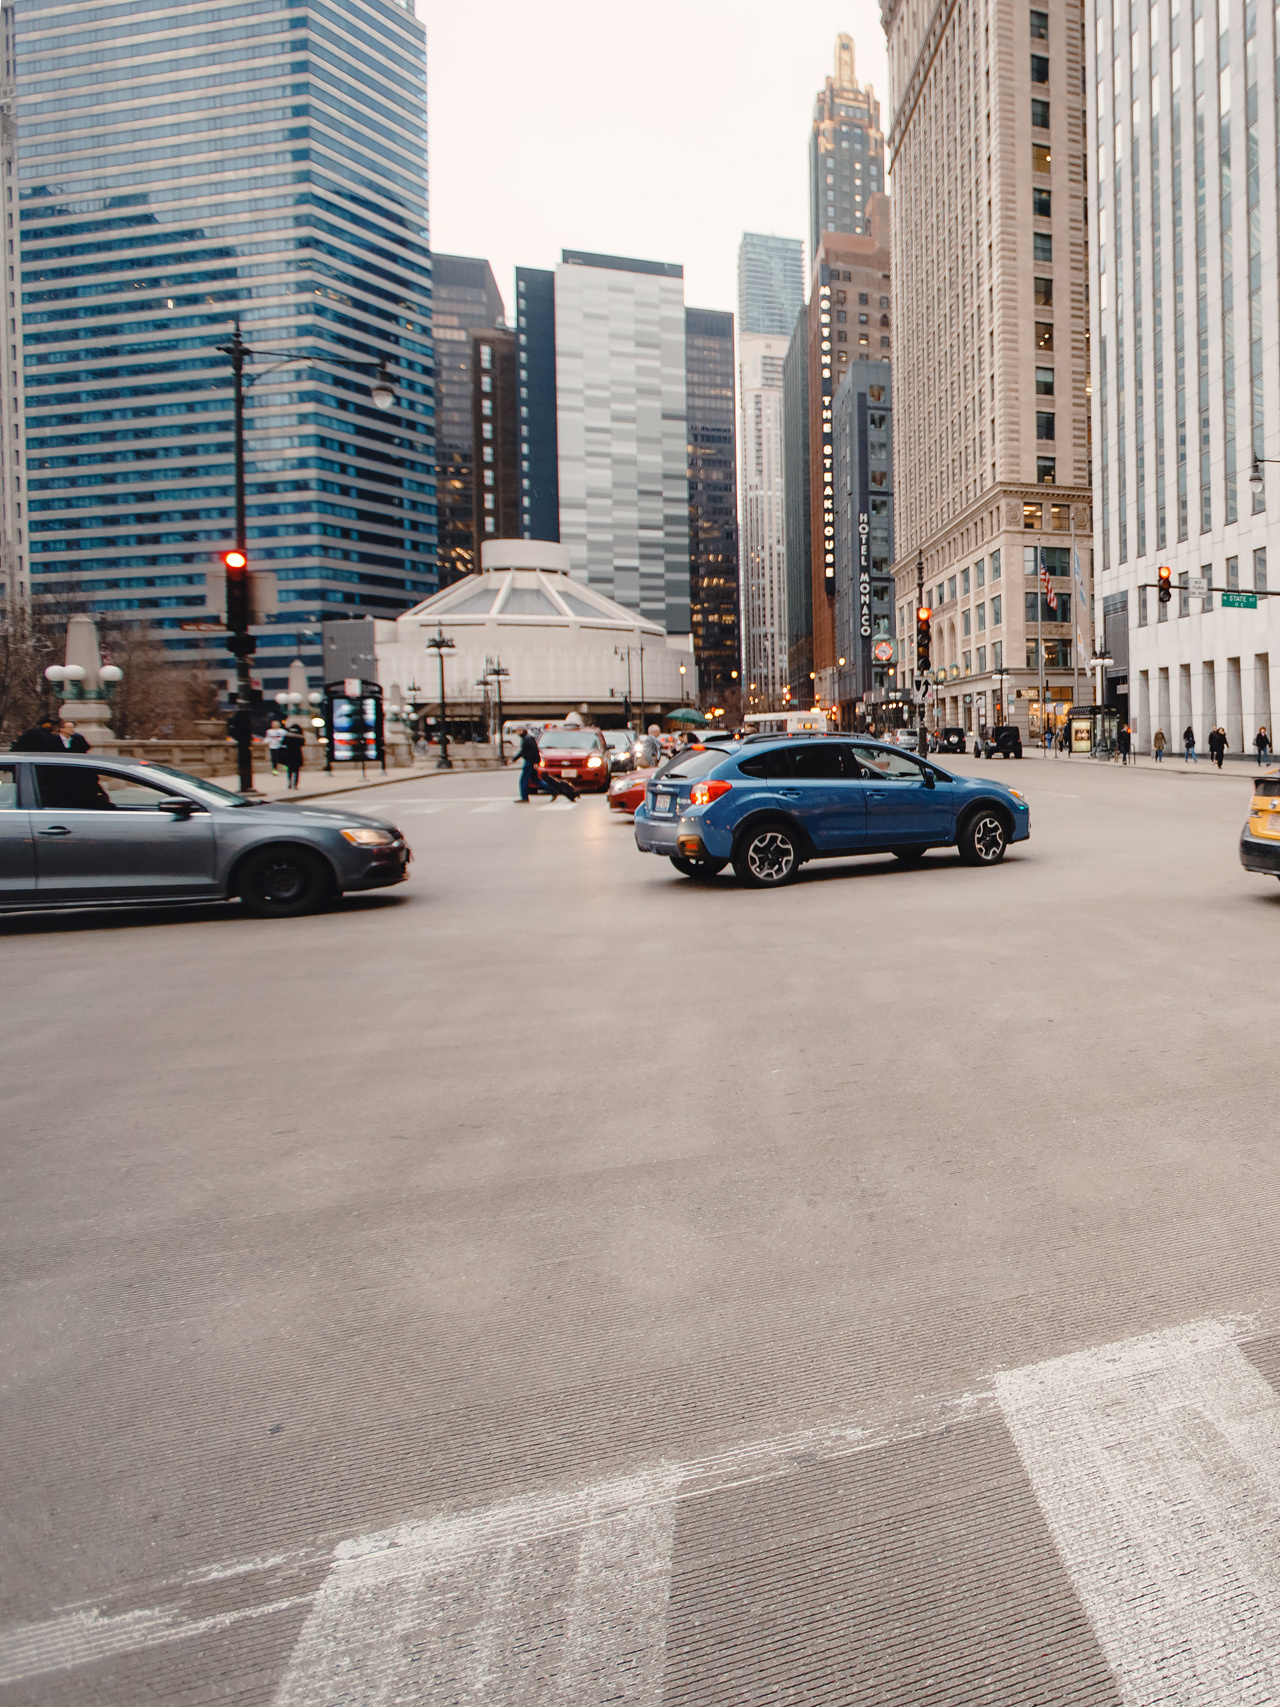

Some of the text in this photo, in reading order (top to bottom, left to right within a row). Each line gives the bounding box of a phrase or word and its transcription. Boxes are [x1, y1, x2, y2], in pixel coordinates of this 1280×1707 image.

[822, 396, 832, 433] THE
[823, 444, 835, 578] STEAKHOUSE
[858, 513, 871, 637] HOTEL MONACO
